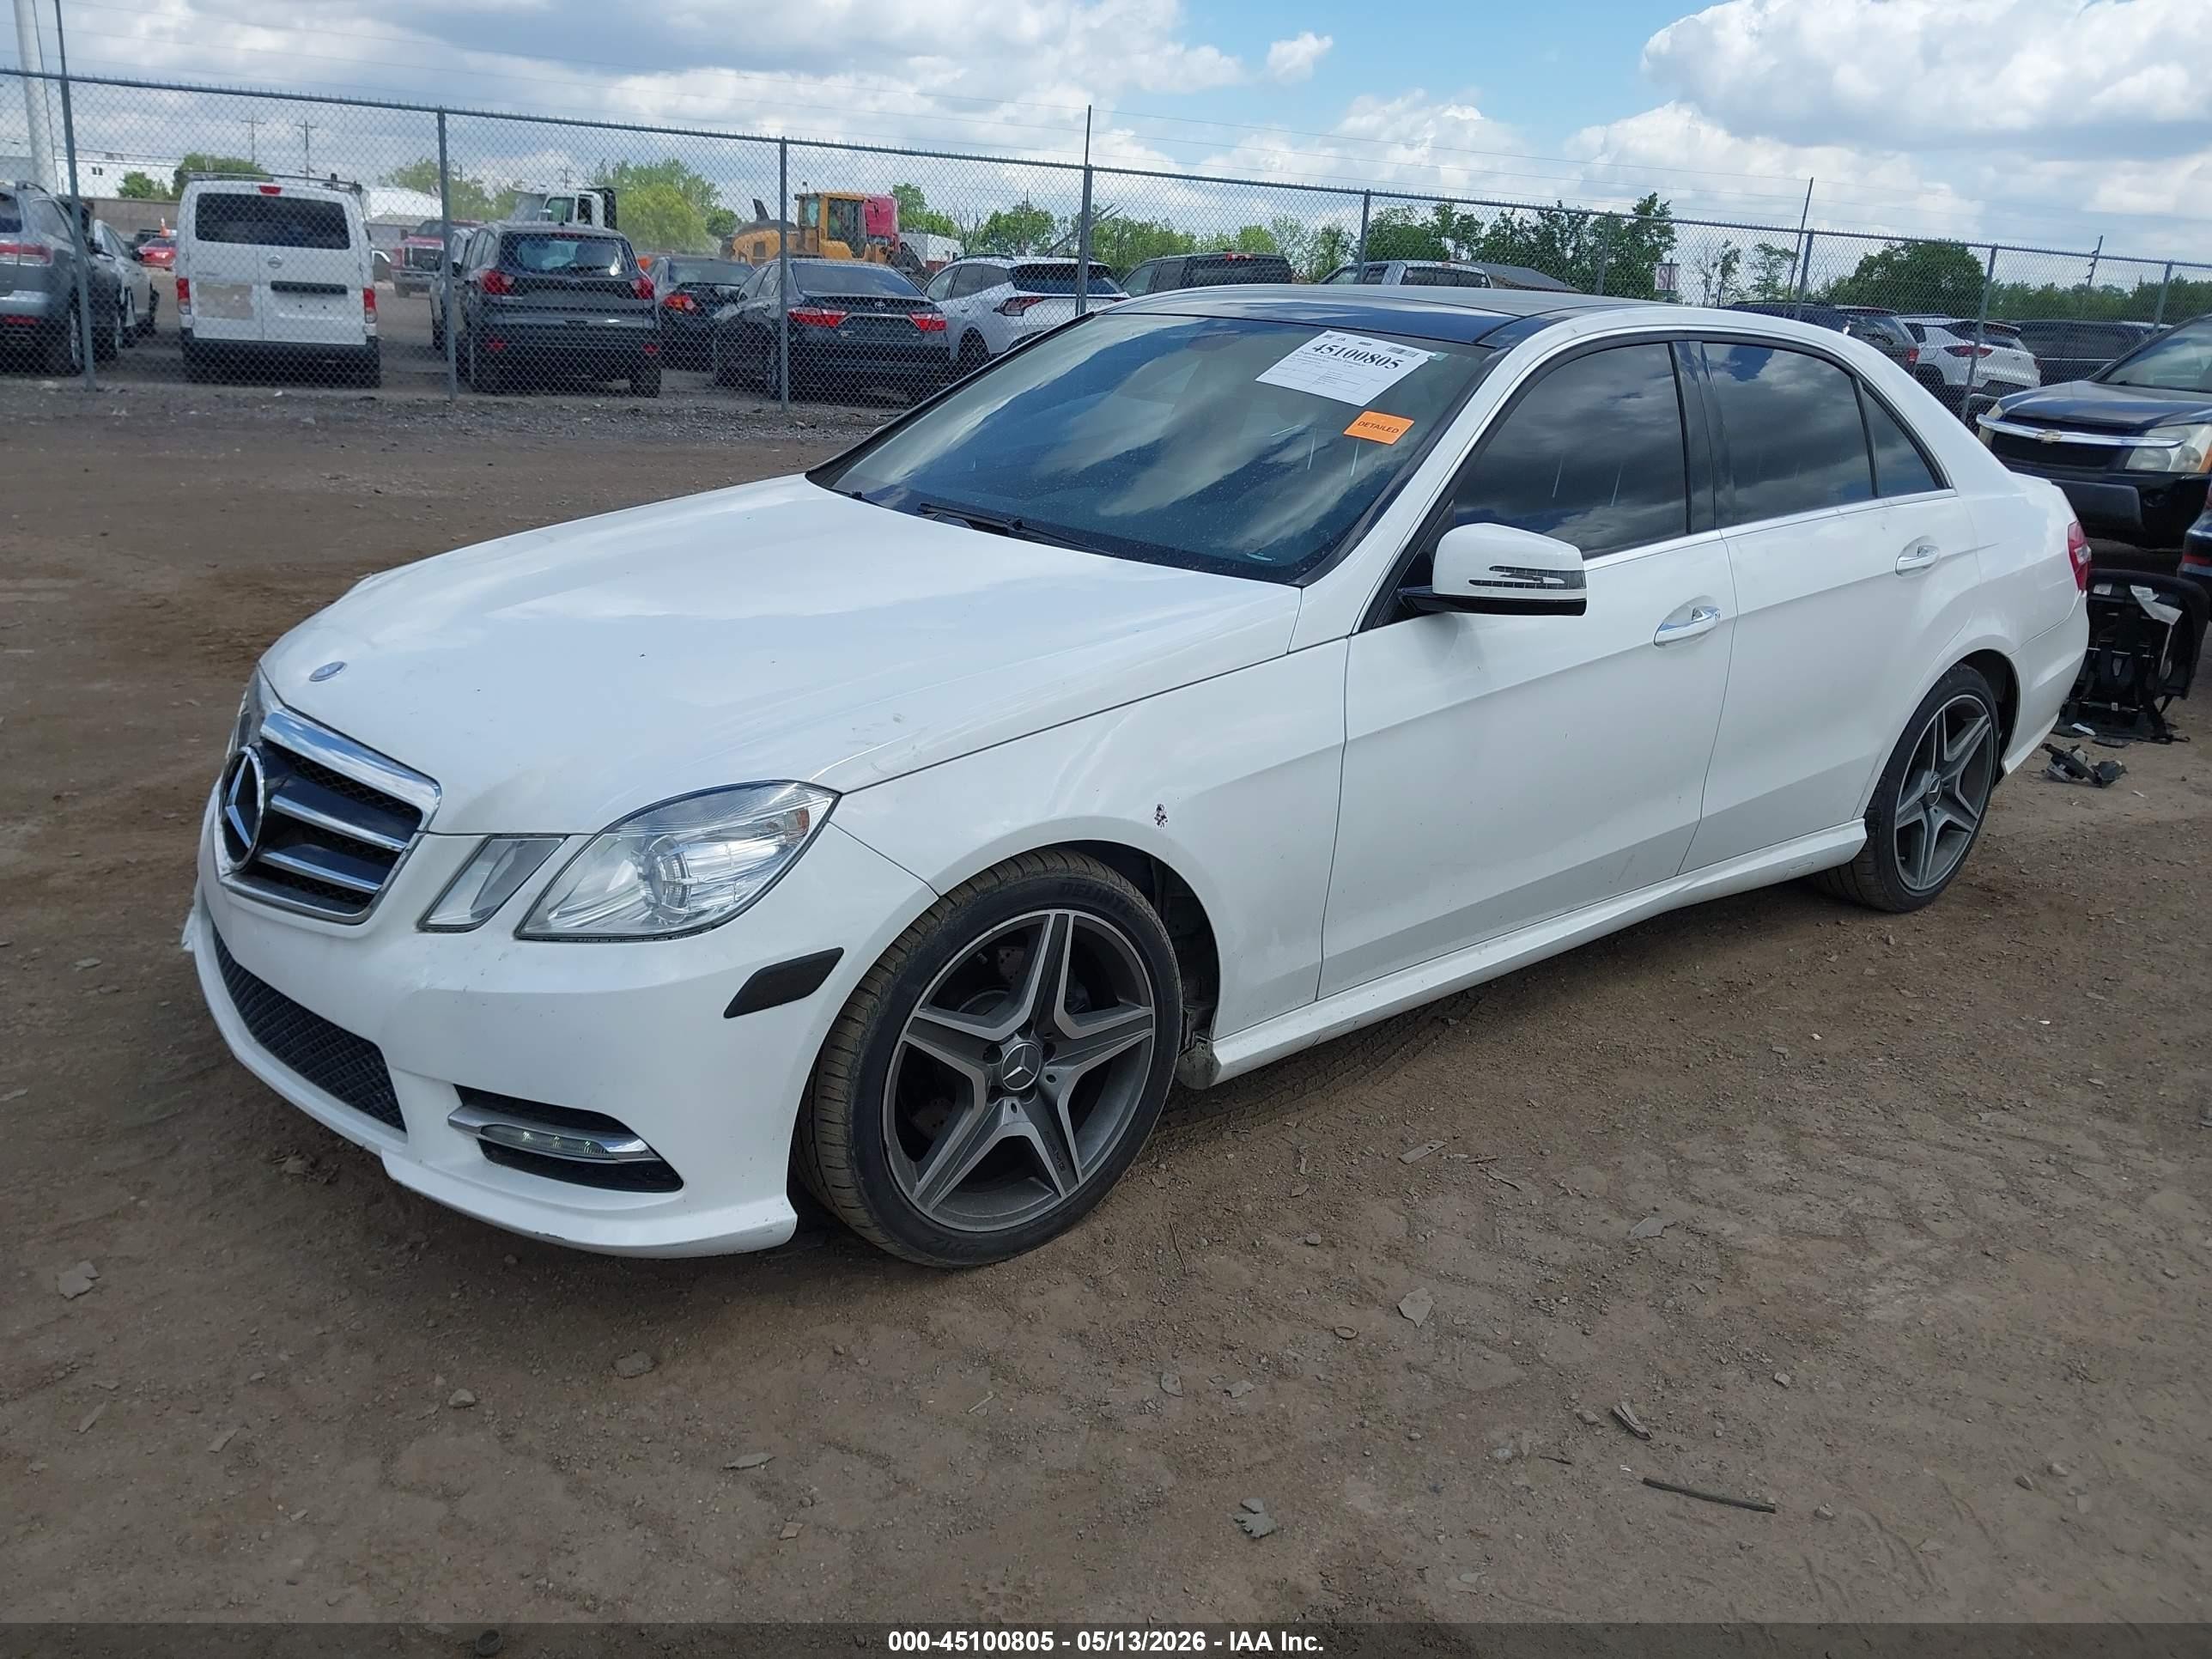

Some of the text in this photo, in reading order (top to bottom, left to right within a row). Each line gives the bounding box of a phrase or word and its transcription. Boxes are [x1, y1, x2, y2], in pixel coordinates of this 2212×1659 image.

[1313, 343, 1404, 369] 45100805
[1358, 421, 1399, 434] DETAILED
[1050, 1144, 1066, 1171] AMG
